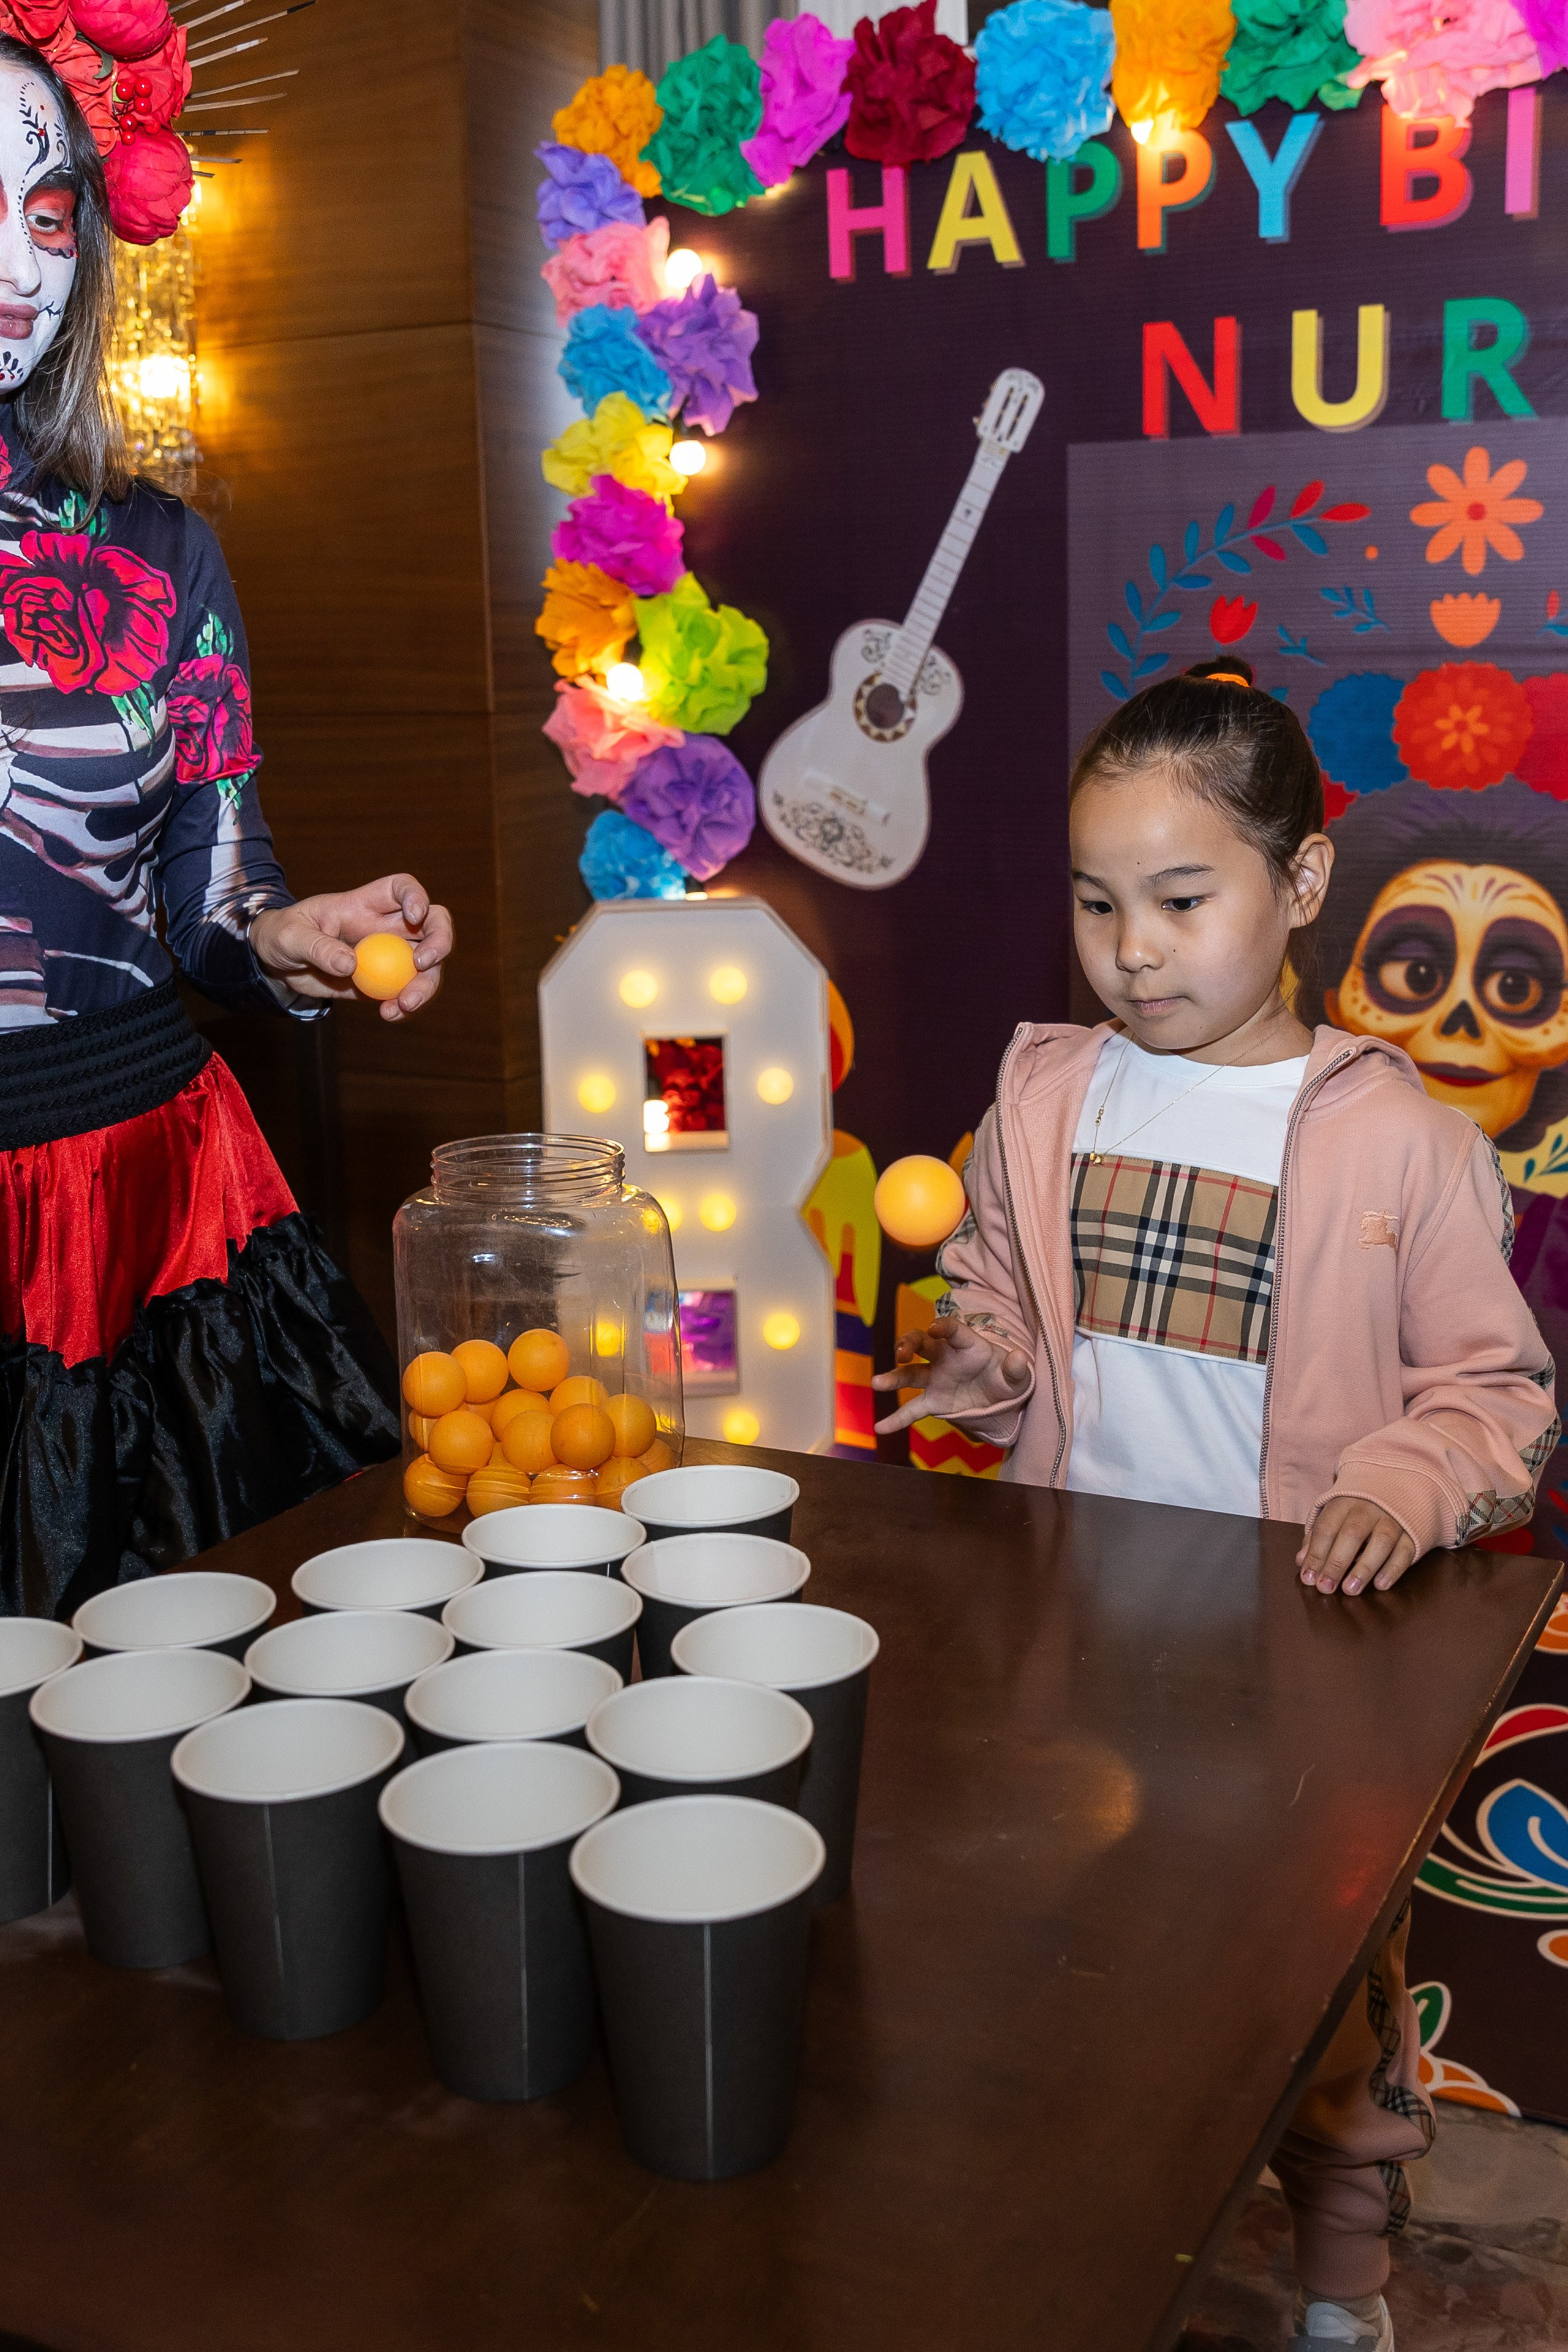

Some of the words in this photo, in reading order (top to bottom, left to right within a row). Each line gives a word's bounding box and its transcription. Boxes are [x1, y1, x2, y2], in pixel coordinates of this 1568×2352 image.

[826, 113, 1324, 283] HAPPY
[1142, 296, 1539, 440] NUR
[539, 898, 834, 1460] 8
